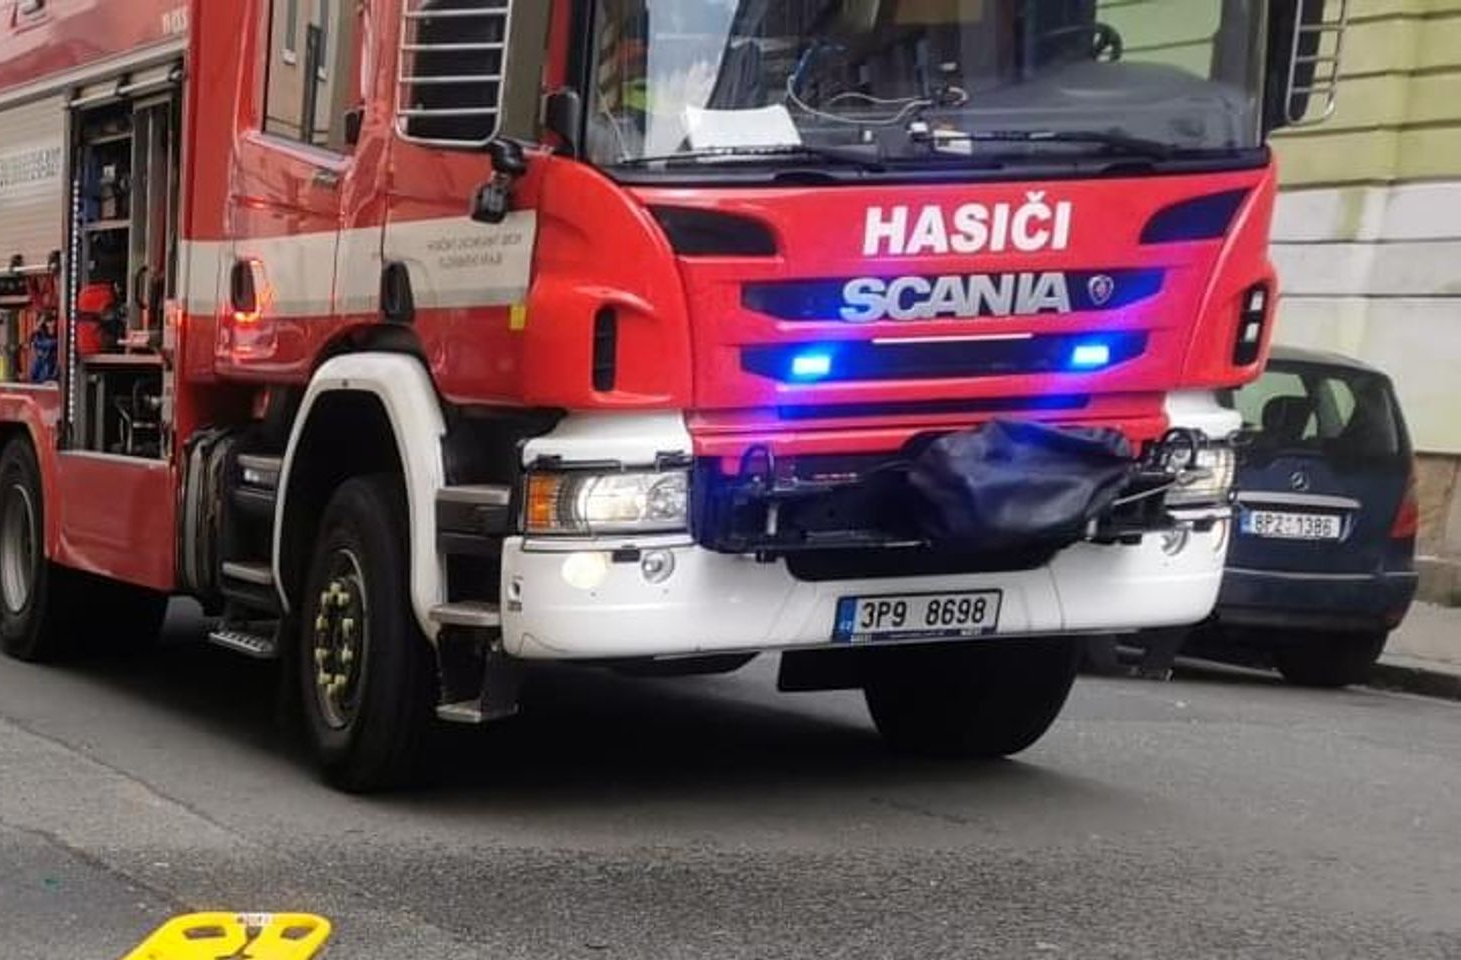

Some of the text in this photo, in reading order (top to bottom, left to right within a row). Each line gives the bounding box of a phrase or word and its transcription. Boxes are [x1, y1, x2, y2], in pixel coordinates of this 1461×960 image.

[862, 190, 1072, 256] HASIČI
[839, 272, 1071, 323] SCANIA
[861, 597, 987, 629] 3P9 8698
